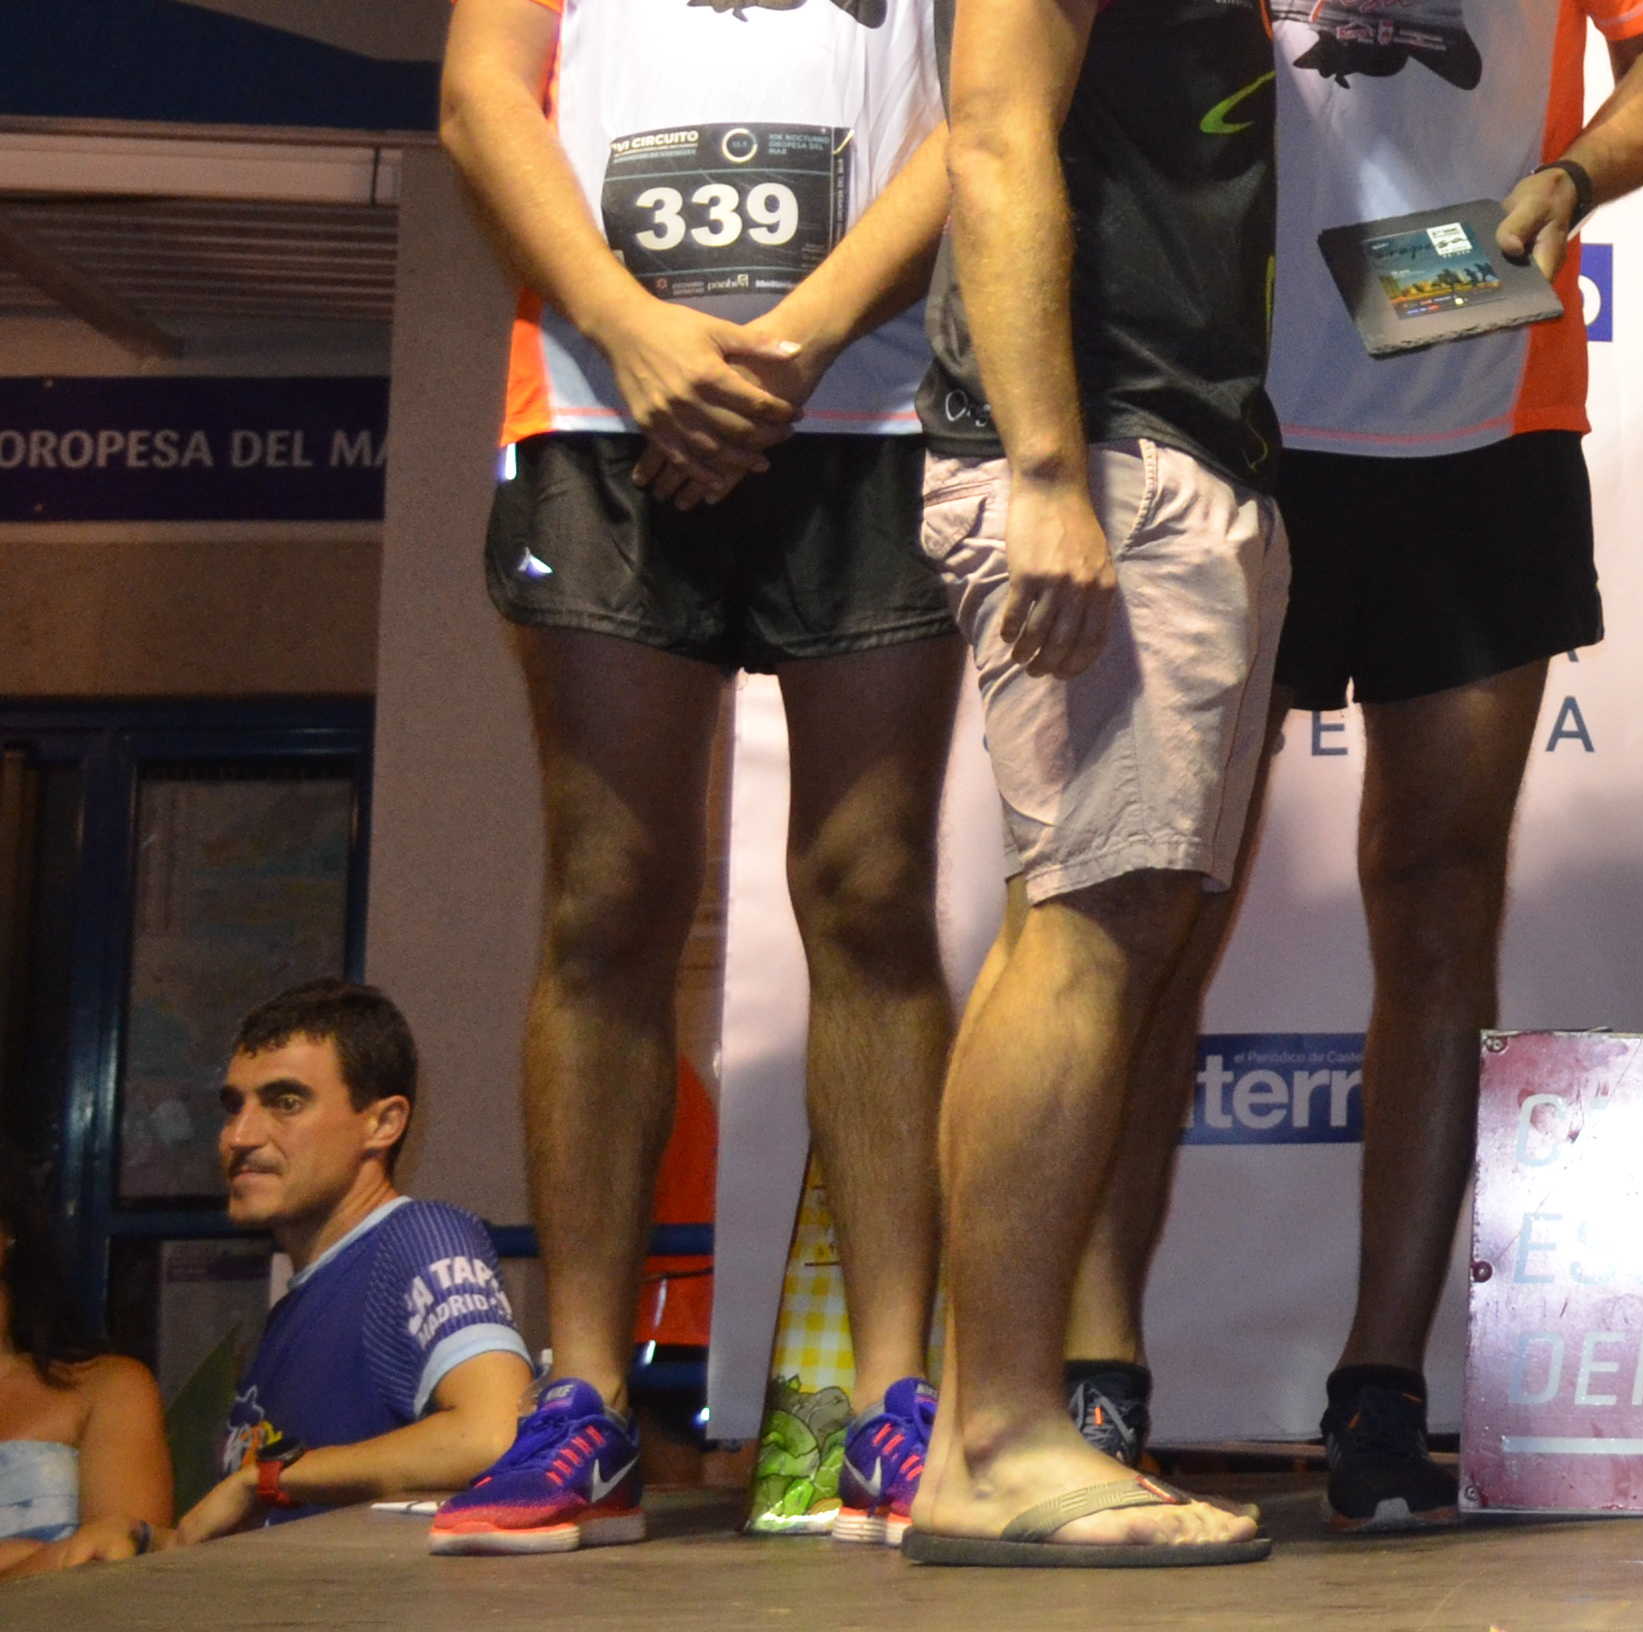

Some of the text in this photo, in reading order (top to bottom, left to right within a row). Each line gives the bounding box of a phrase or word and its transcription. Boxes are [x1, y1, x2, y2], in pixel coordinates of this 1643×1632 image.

[631, 130, 699, 149] CIRCUITO
[635, 182, 799, 251] 339
[0, 429, 214, 469] OROPESA
[230, 430, 312, 469] DEL
